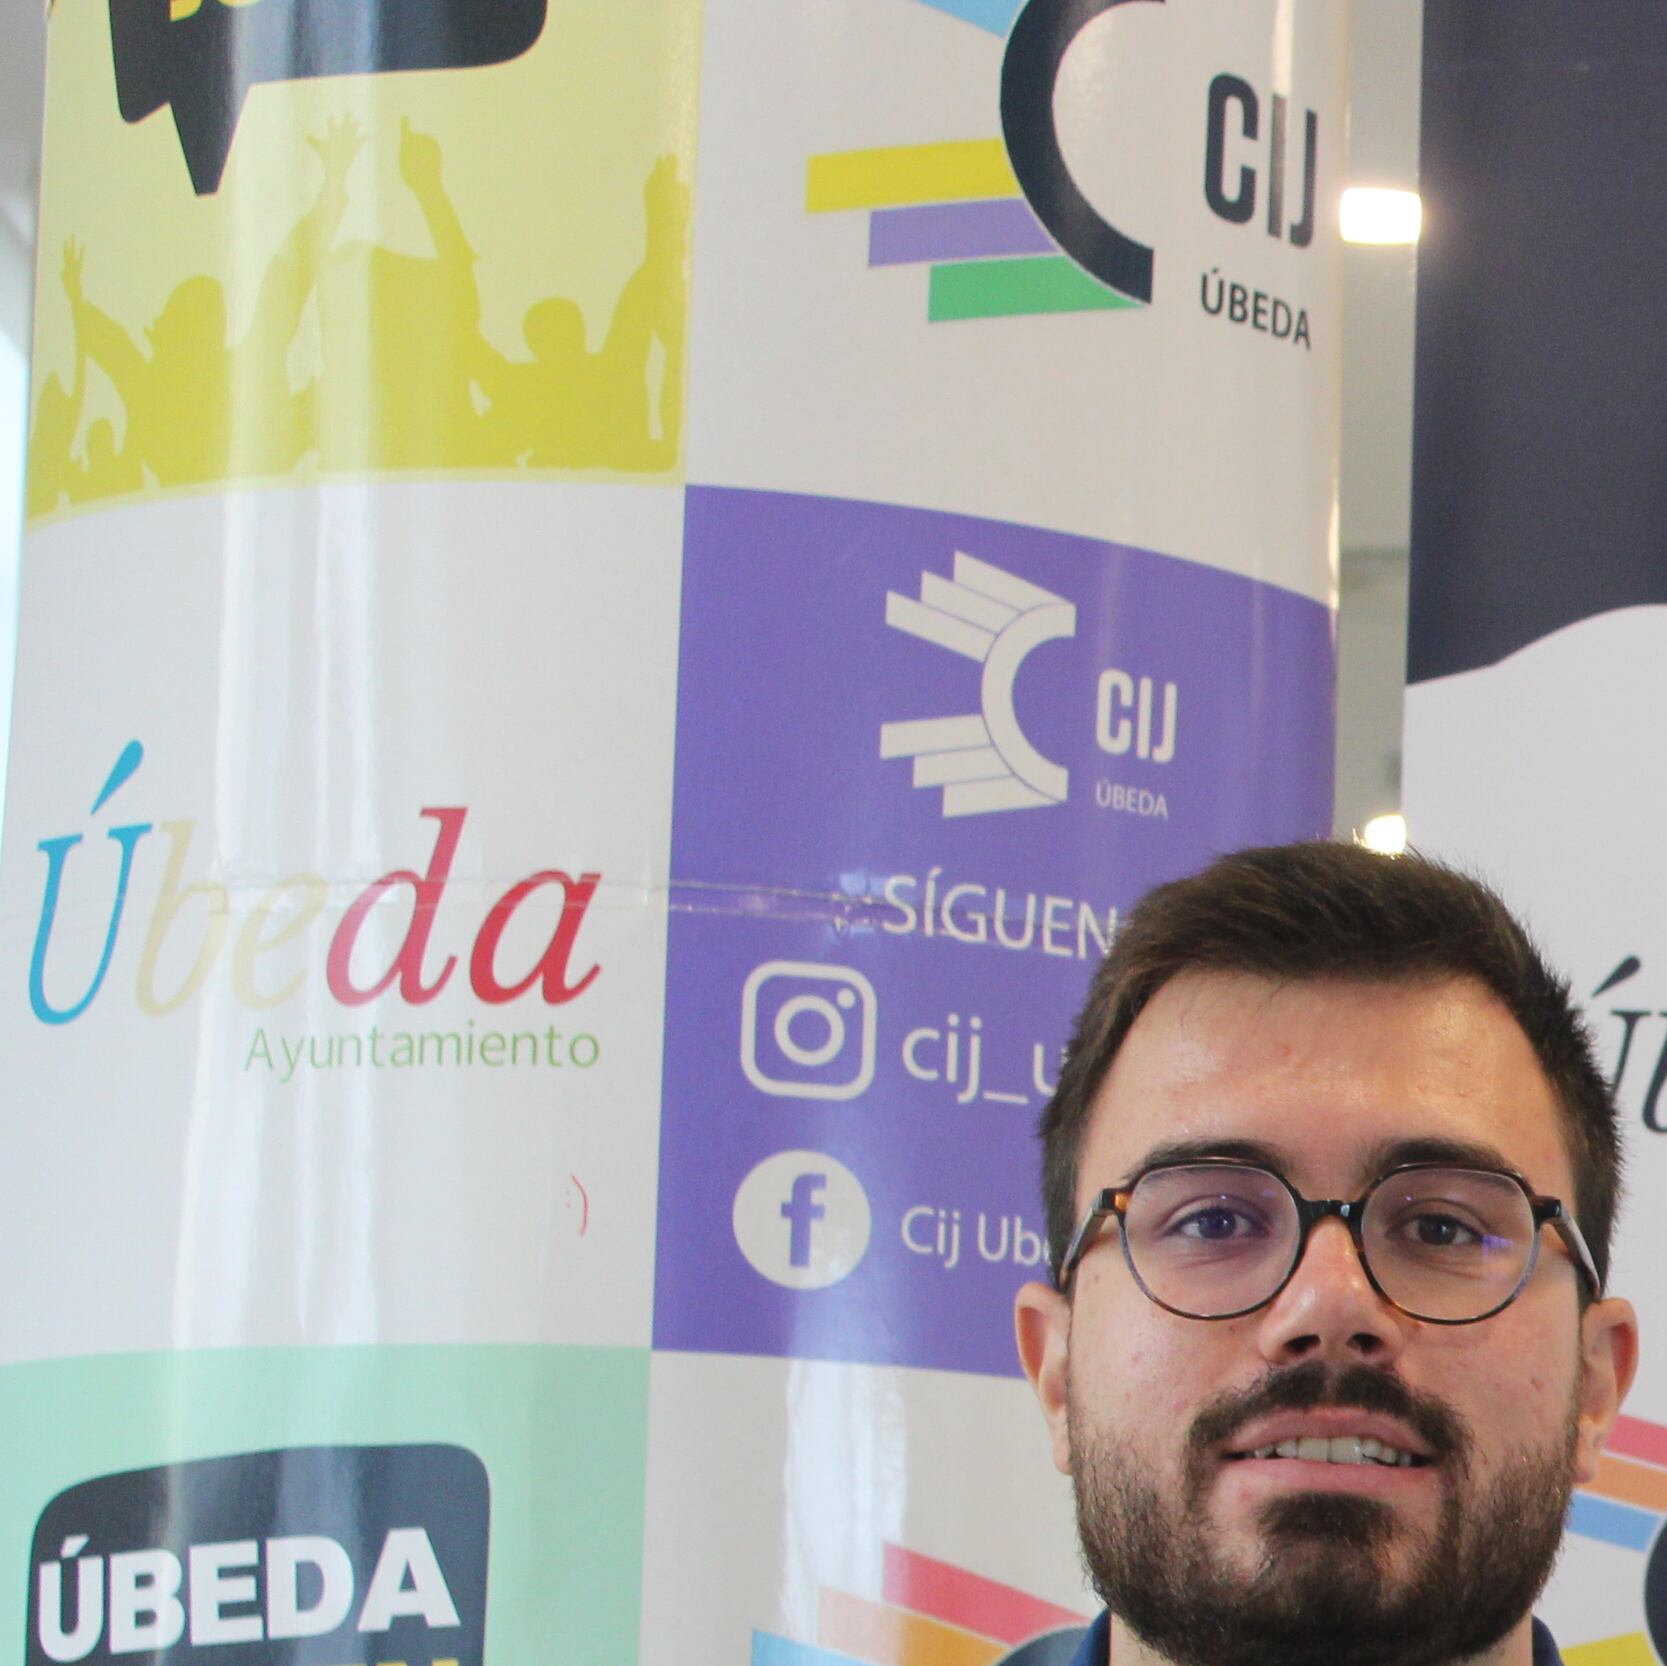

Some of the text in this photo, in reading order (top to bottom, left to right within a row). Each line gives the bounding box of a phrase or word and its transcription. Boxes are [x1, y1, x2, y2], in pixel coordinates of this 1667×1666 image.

[1203, 72, 1318, 249] CIJ
[1201, 266, 1312, 350] ÚBEDA
[1096, 668, 1178, 763] CIJ
[1096, 781, 1169, 820] ÚBEDA
[28, 739, 602, 1024] Úbeda
[244, 1020, 601, 1083] Ayuntamiento
[901, 1204, 961, 1270] Cij
[37, 1526, 461, 1663] ÚBEDA
